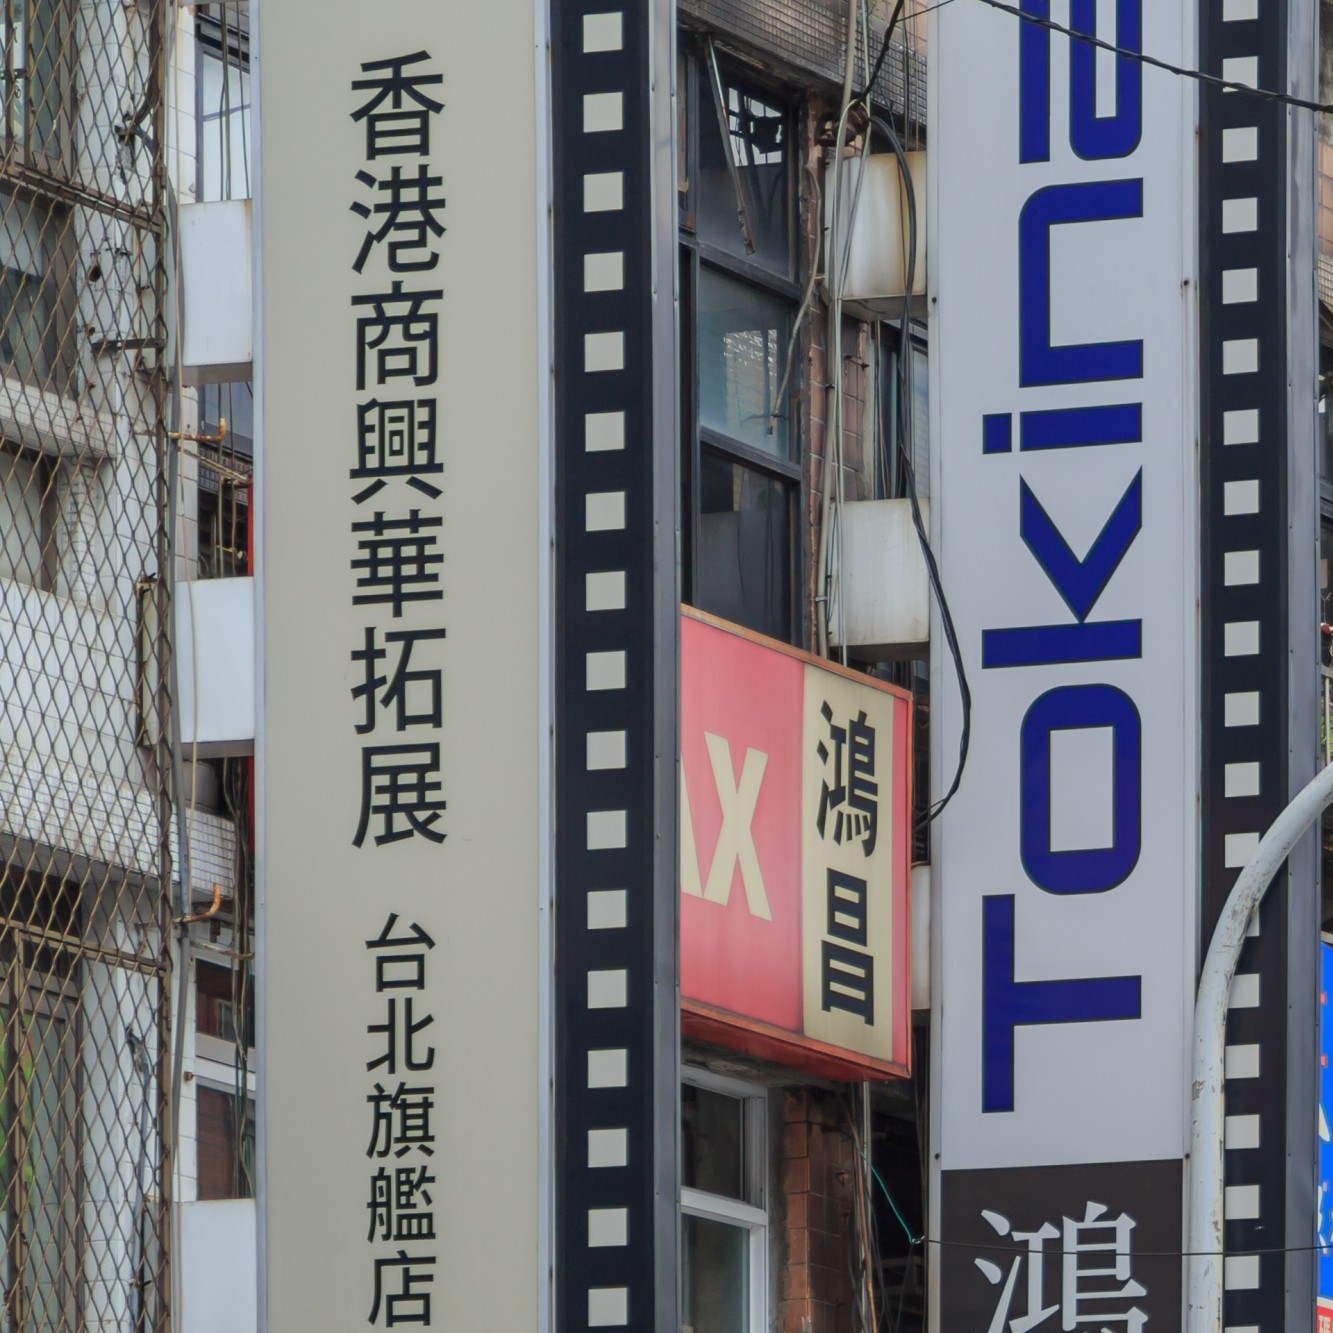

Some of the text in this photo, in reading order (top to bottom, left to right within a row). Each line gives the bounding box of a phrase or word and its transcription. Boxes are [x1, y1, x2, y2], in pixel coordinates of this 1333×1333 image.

[350, 50, 448, 1329] 香港商興華拓展 台北旗艦店
[816, 700, 878, 1027] 鴻昌
